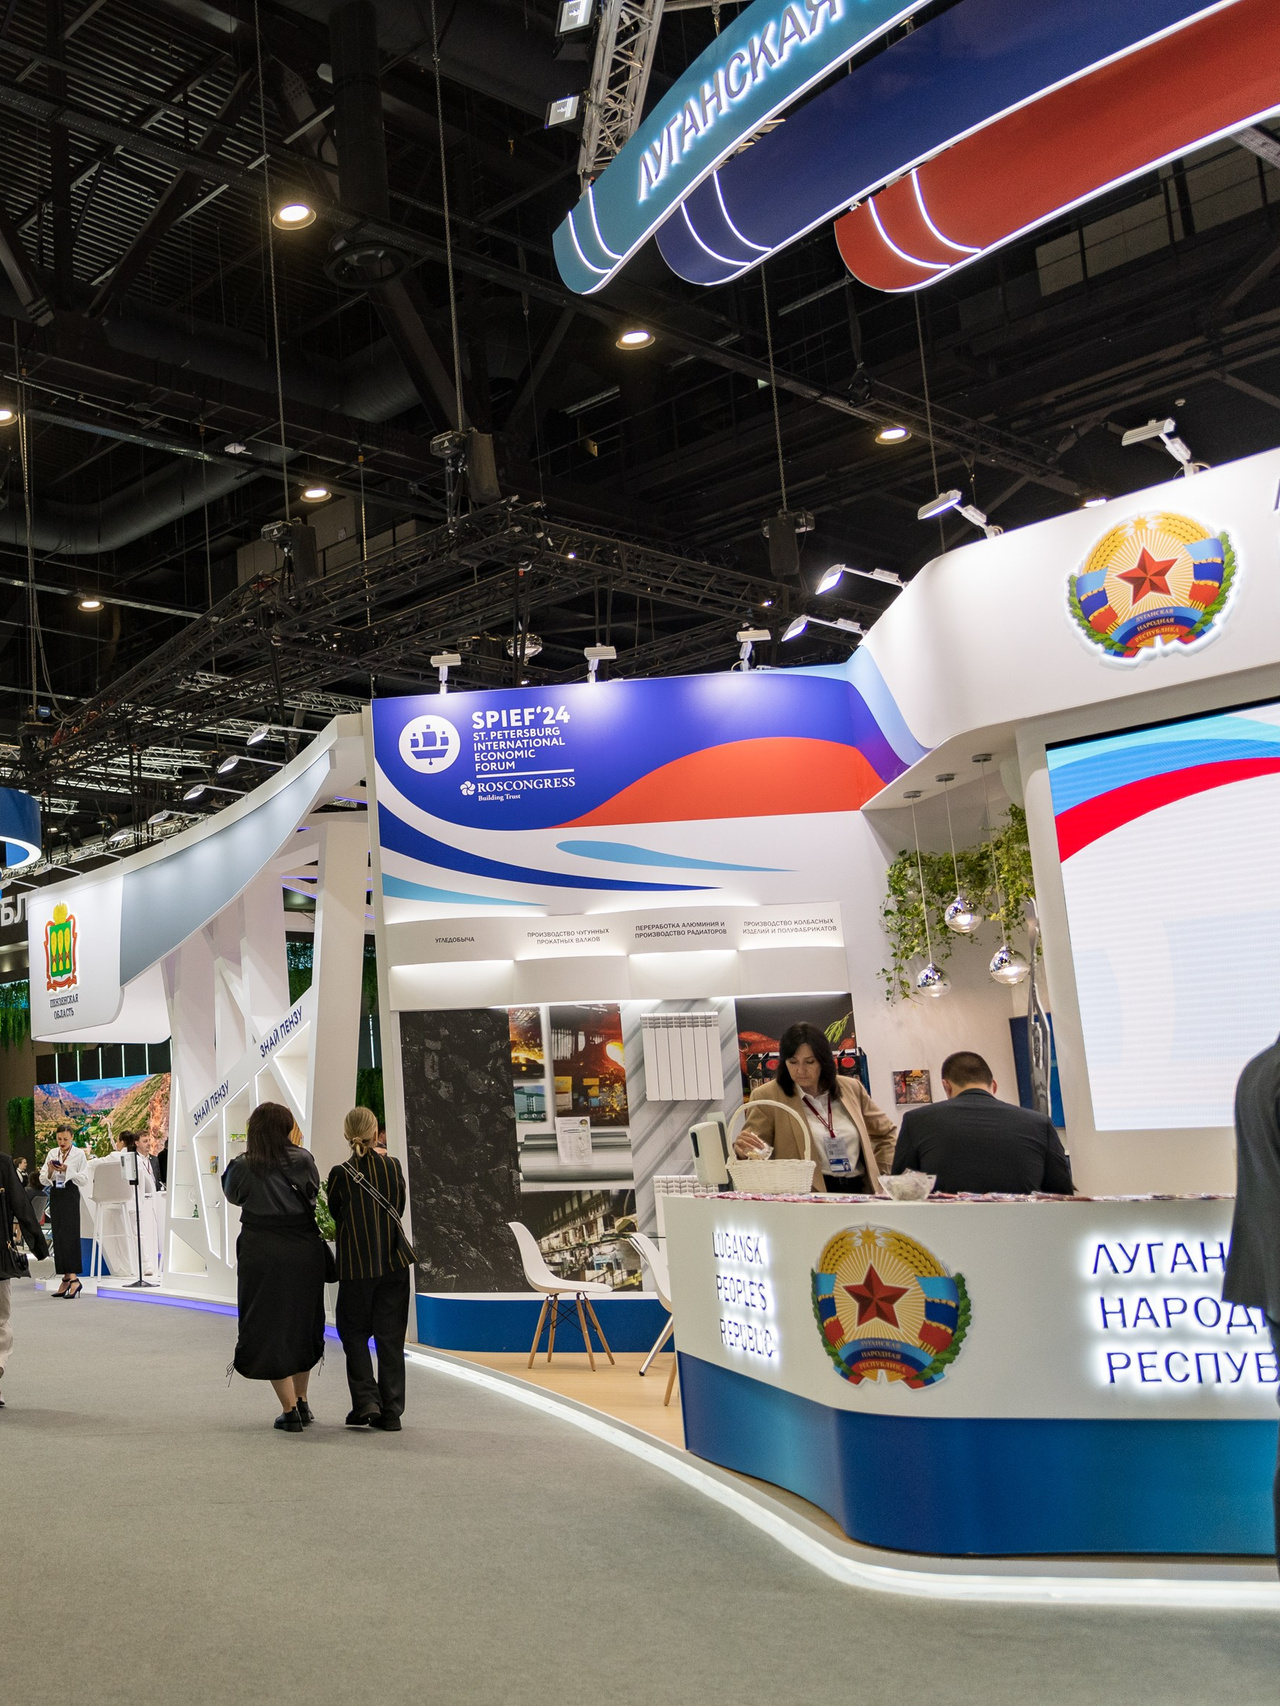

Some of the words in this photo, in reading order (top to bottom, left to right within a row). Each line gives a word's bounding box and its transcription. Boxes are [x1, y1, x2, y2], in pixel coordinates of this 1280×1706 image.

[473, 731, 488, 741] ST.
[490, 727, 560, 740] PETERSBURG
[473, 737, 566, 751] INTERNATIONAL
[474, 749, 536, 762] ECONOMIC
[475, 761, 516, 772] FORUM
[477, 777, 576, 793] ROSCONGRESS
[478, 794, 505, 802] Building
[635, 922, 680, 931] ПЕРЕРАБОТКА
[742, 926, 770, 935] ИЗДЕЛИЙ
[777, 926, 838, 934] ПОЛУФАБРИКАТОВ
[527, 930, 575, 938] ПРОИЗВОДСТВО
[576, 928, 610, 936] ЧУГУННЫХ
[634, 930, 686, 939] ПРОИЗВОДСТВО
[687, 928, 728, 936] РАДИАТОРОВ
[435, 936, 475, 944] УГЛЕДОБЫЧА
[575, 936, 601, 944] ВАЛКОВ
[260, 1028, 280, 1058] ЗНАЙ
[280, 1005, 302, 1039] ПЕНЗУ
[193, 1099, 210, 1126] ЗНАЙ
[210, 1080, 229, 1109] ПЕНЗУ
[711, 1231, 763, 1265] LUGANSK
[719, 1318, 775, 1358] REPUBLIC
